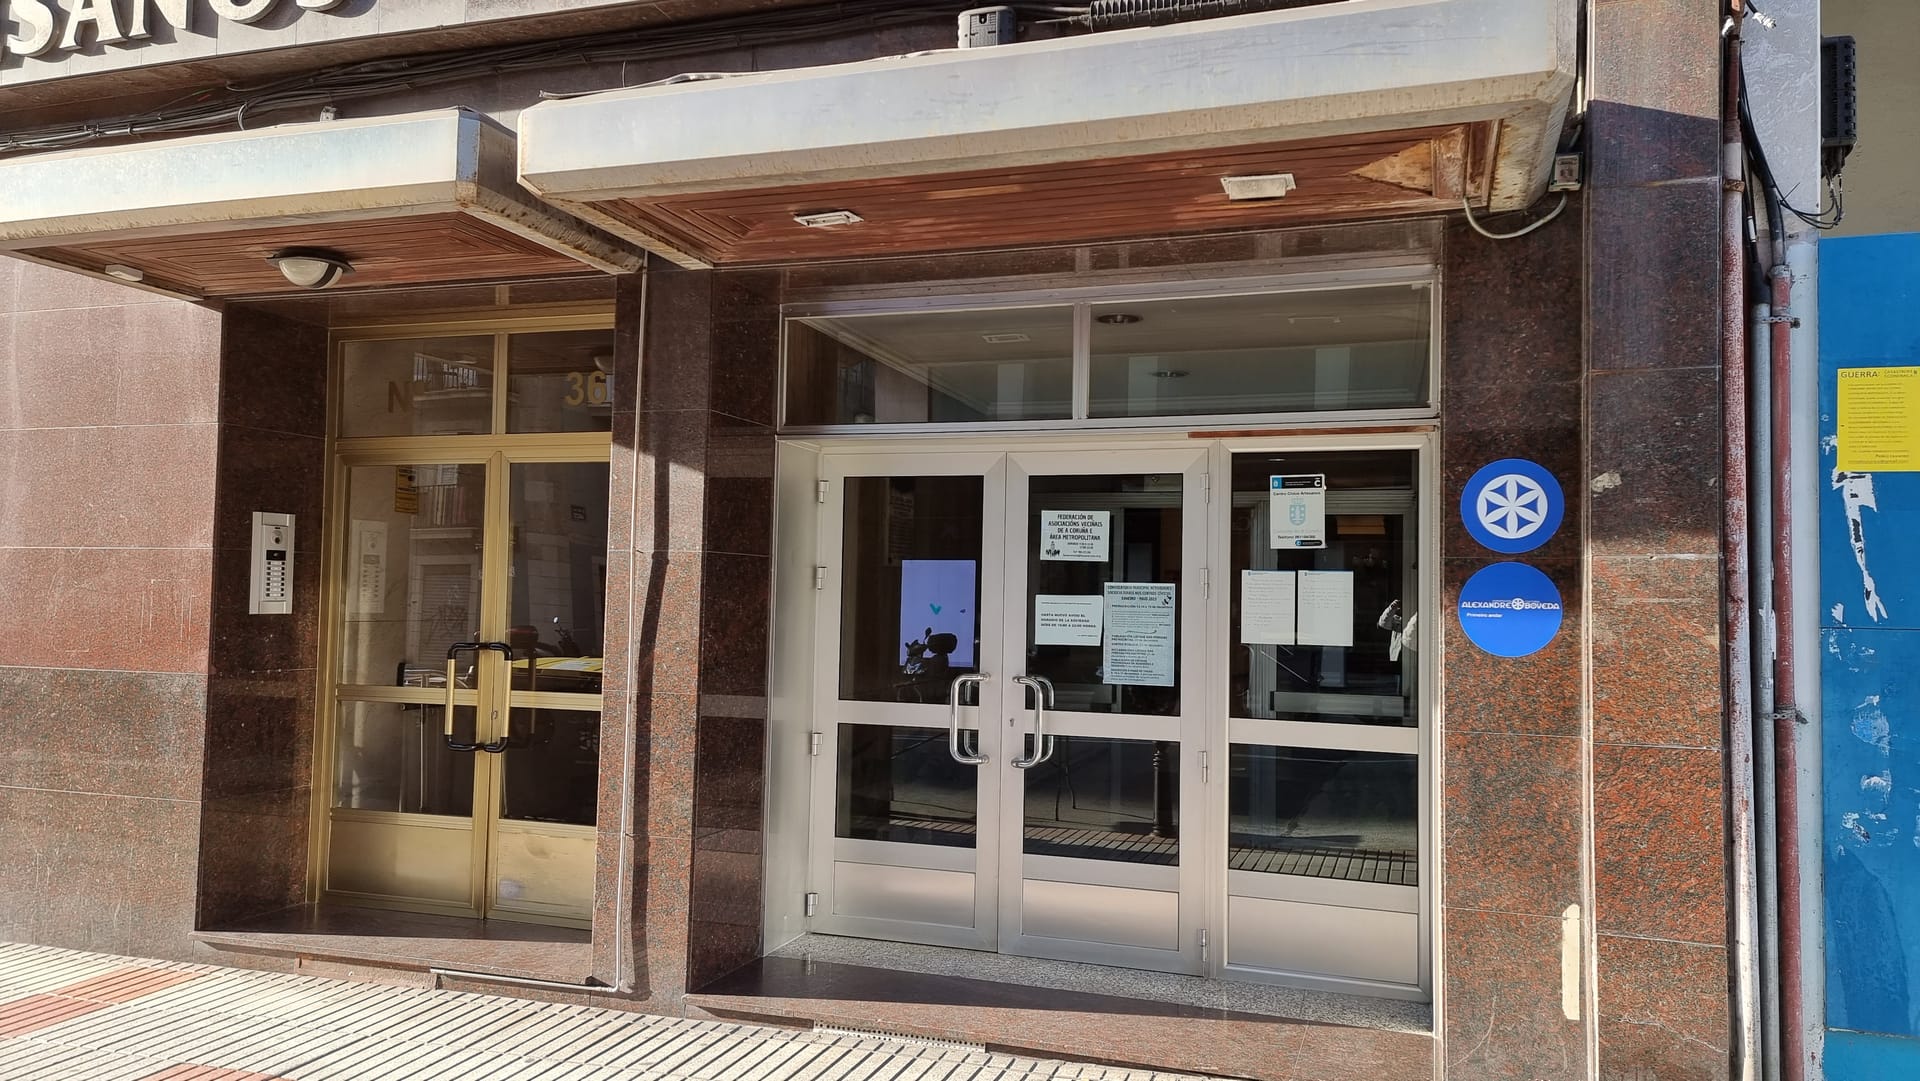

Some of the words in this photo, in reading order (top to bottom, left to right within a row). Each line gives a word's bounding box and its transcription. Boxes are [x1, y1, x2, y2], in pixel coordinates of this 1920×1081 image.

[565, 370, 606, 406] 36
[1048, 519, 1080, 527] ASOCIACIÓNS
[1069, 526, 1088, 534] CORUÑA
[1461, 601, 1513, 609] ALEXANDRE
[1524, 602, 1561, 610] BOVEDA
